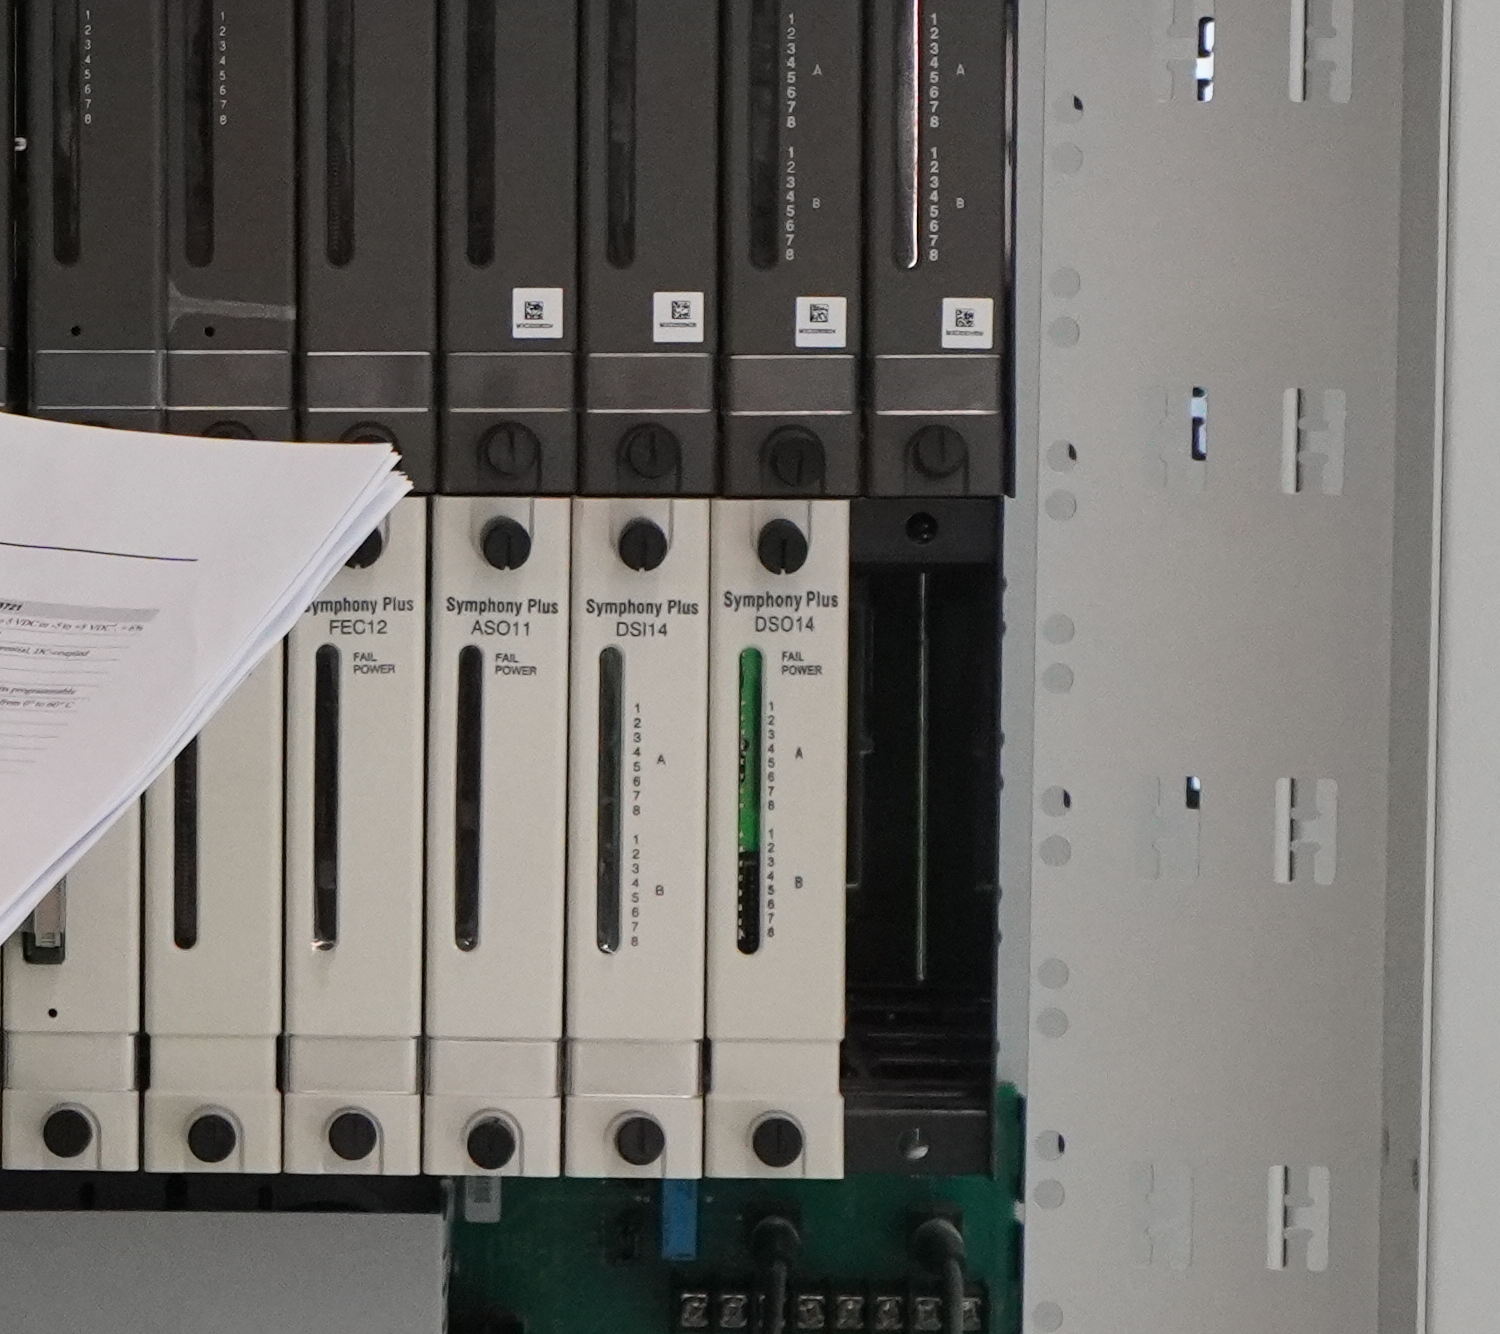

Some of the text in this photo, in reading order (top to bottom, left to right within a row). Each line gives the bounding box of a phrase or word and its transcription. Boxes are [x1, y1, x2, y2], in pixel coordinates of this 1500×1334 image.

[812, 63, 823, 76] A
[956, 63, 965, 76] A
[812, 197, 821, 209] B
[955, 197, 965, 209] B
[382, 596, 414, 612] Plus
[446, 596, 559, 617] Symphony Plus
[723, 590, 839, 612] Symphony Plus
[585, 598, 699, 618] Symphony Plus
[329, 619, 388, 635] FEC12
[353, 651, 377, 662] FAIL
[495, 652, 519, 664] FAIL
[781, 651, 803, 662] FAIL
[353, 664, 395, 675] POWER
[495, 665, 537, 676] POWER
[782, 665, 821, 676] POWER
[632, 702, 642, 817] 1 2 3 4 5 6 7 8
[656, 754, 666, 765] A
[766, 700, 776, 811] 1 2 3 4 5 6 7 8
[795, 747, 803, 759] A
[766, 828, 776, 938] 1 2 3 4 5 6 7 8
[794, 876, 803, 889] B
[630, 834, 641, 948] 1 2 3 4 5 6 7 8
[655, 884, 665, 896] B
